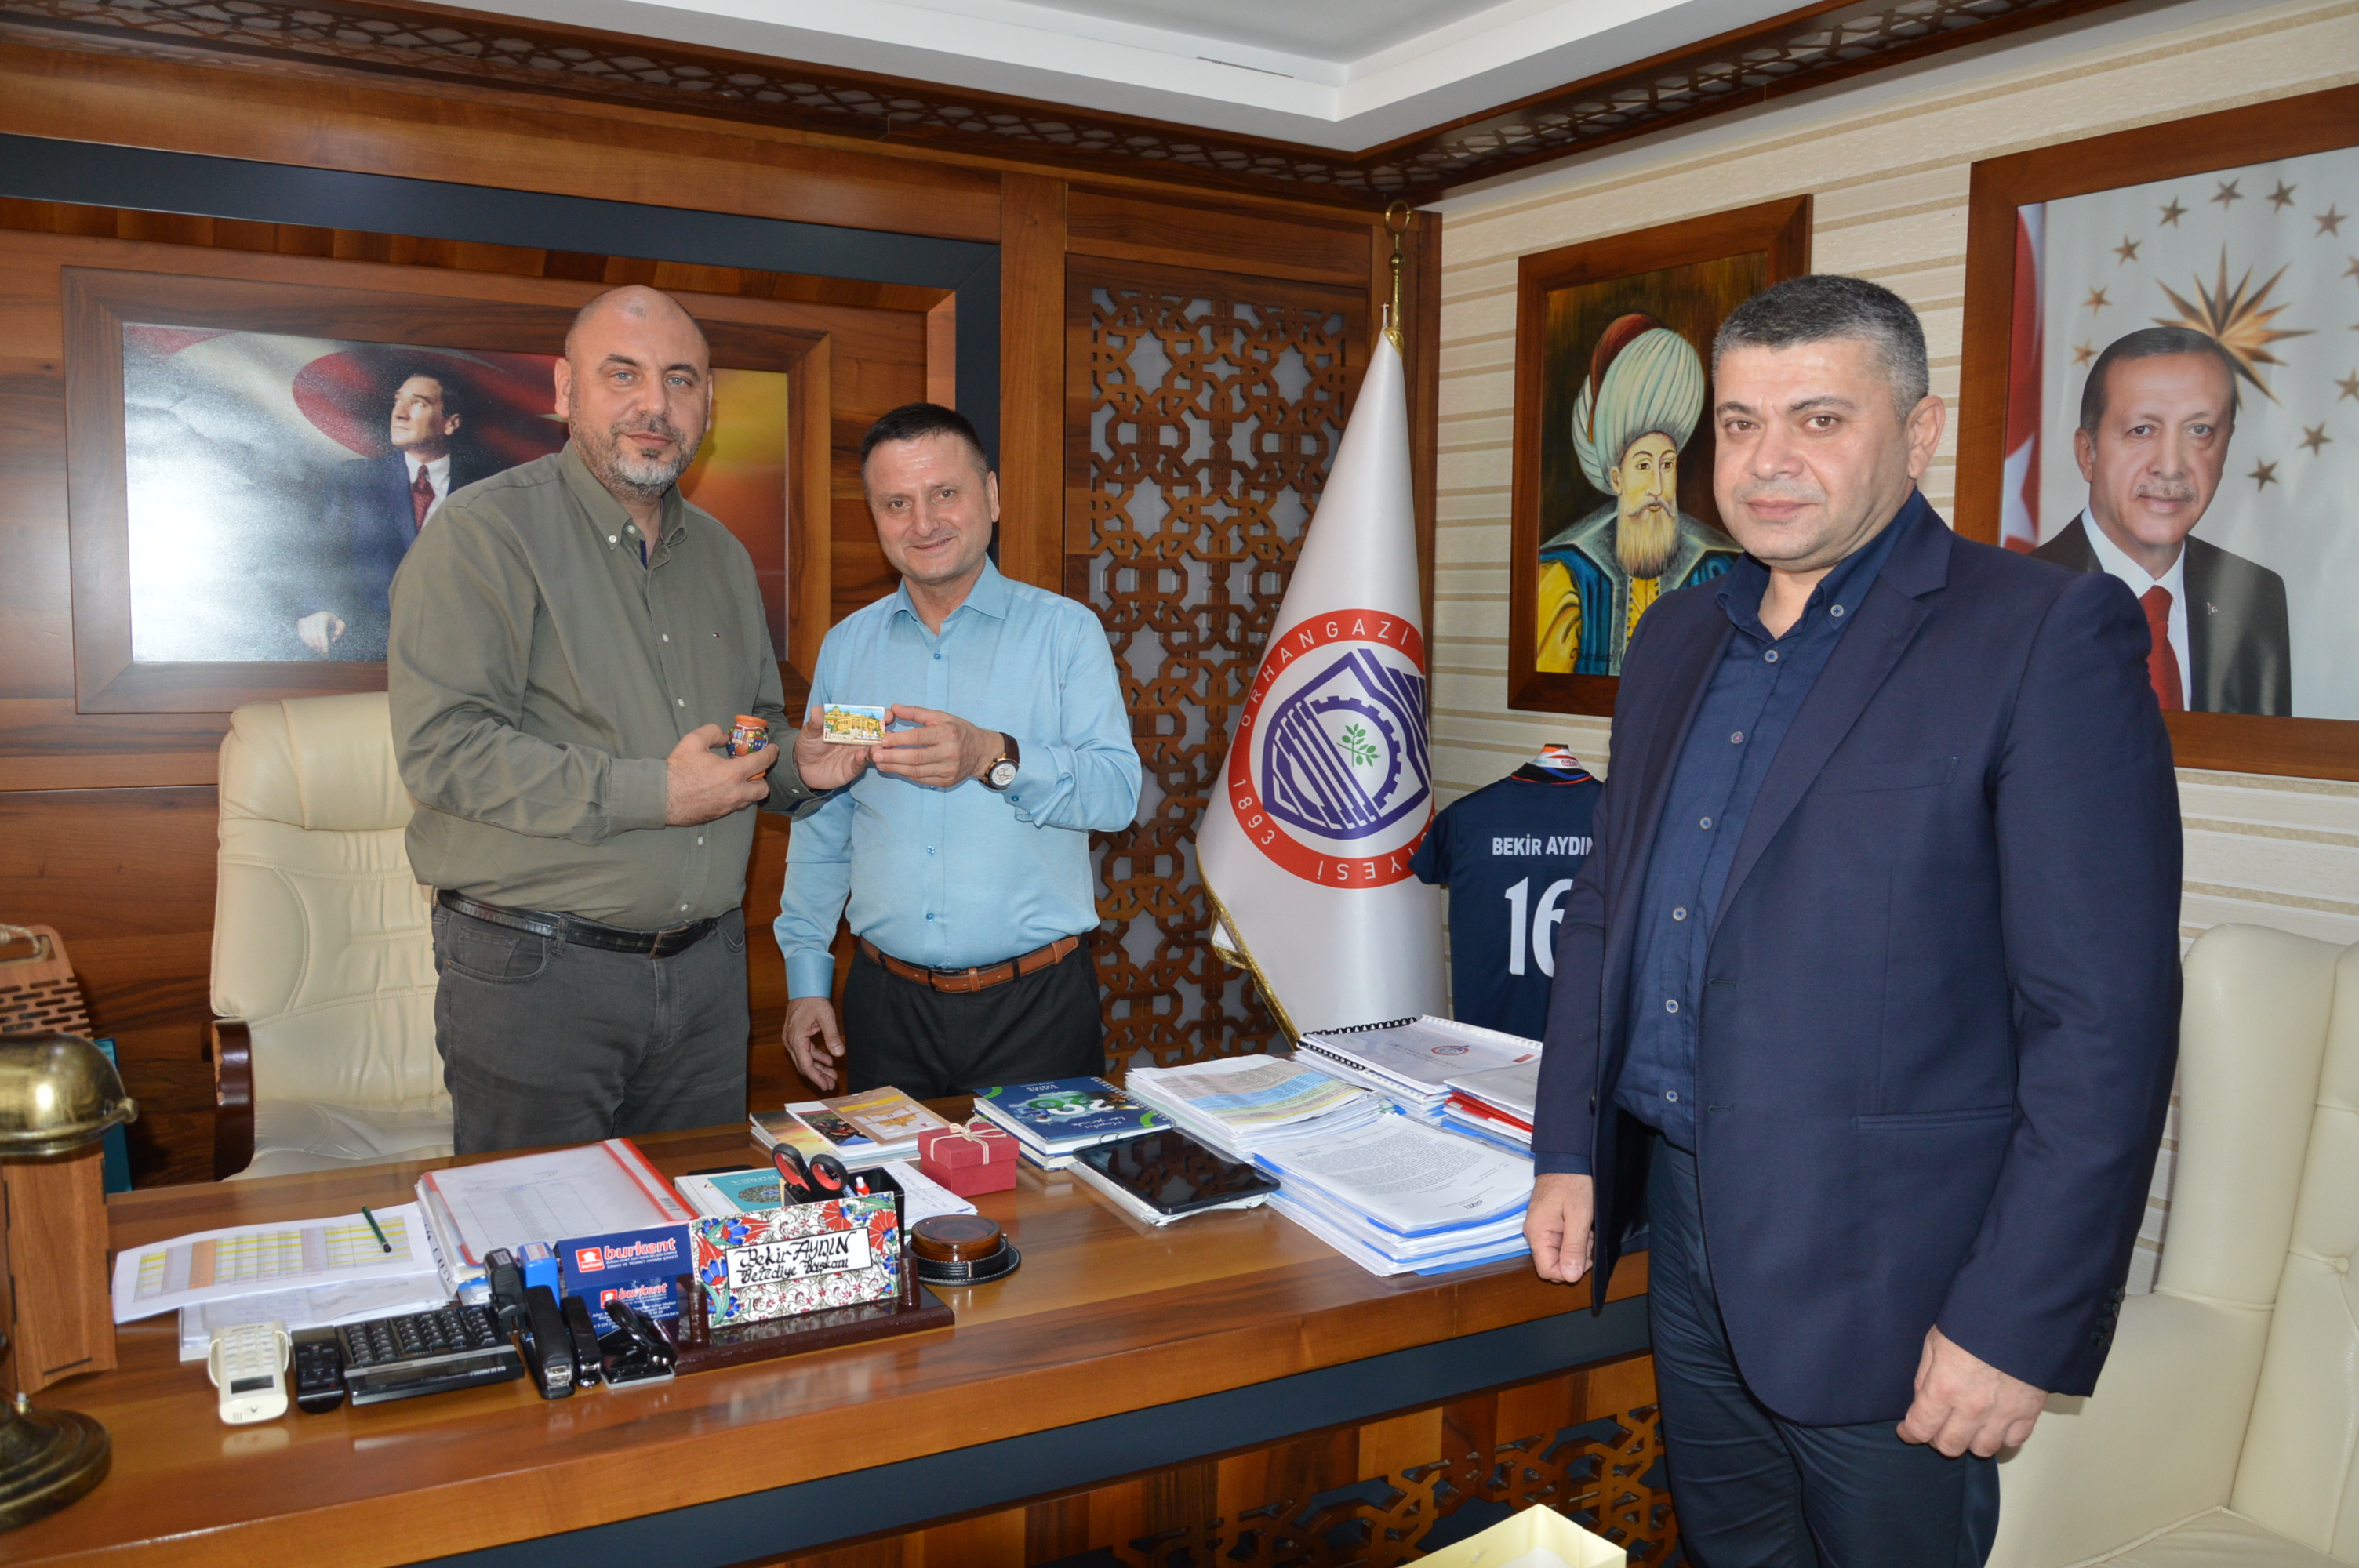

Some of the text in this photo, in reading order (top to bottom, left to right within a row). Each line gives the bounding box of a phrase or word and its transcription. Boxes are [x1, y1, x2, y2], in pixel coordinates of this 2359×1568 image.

[1241, 618, 1409, 728] ORHANGAZİ
[1233, 779, 1275, 845] 1893
[1492, 833, 1541, 856] BEKİR
[1505, 877, 1574, 978] 16
[604, 1238, 676, 1259] burkent
[734, 1246, 792, 1268] Bekir
[619, 1283, 667, 1299] burkent
